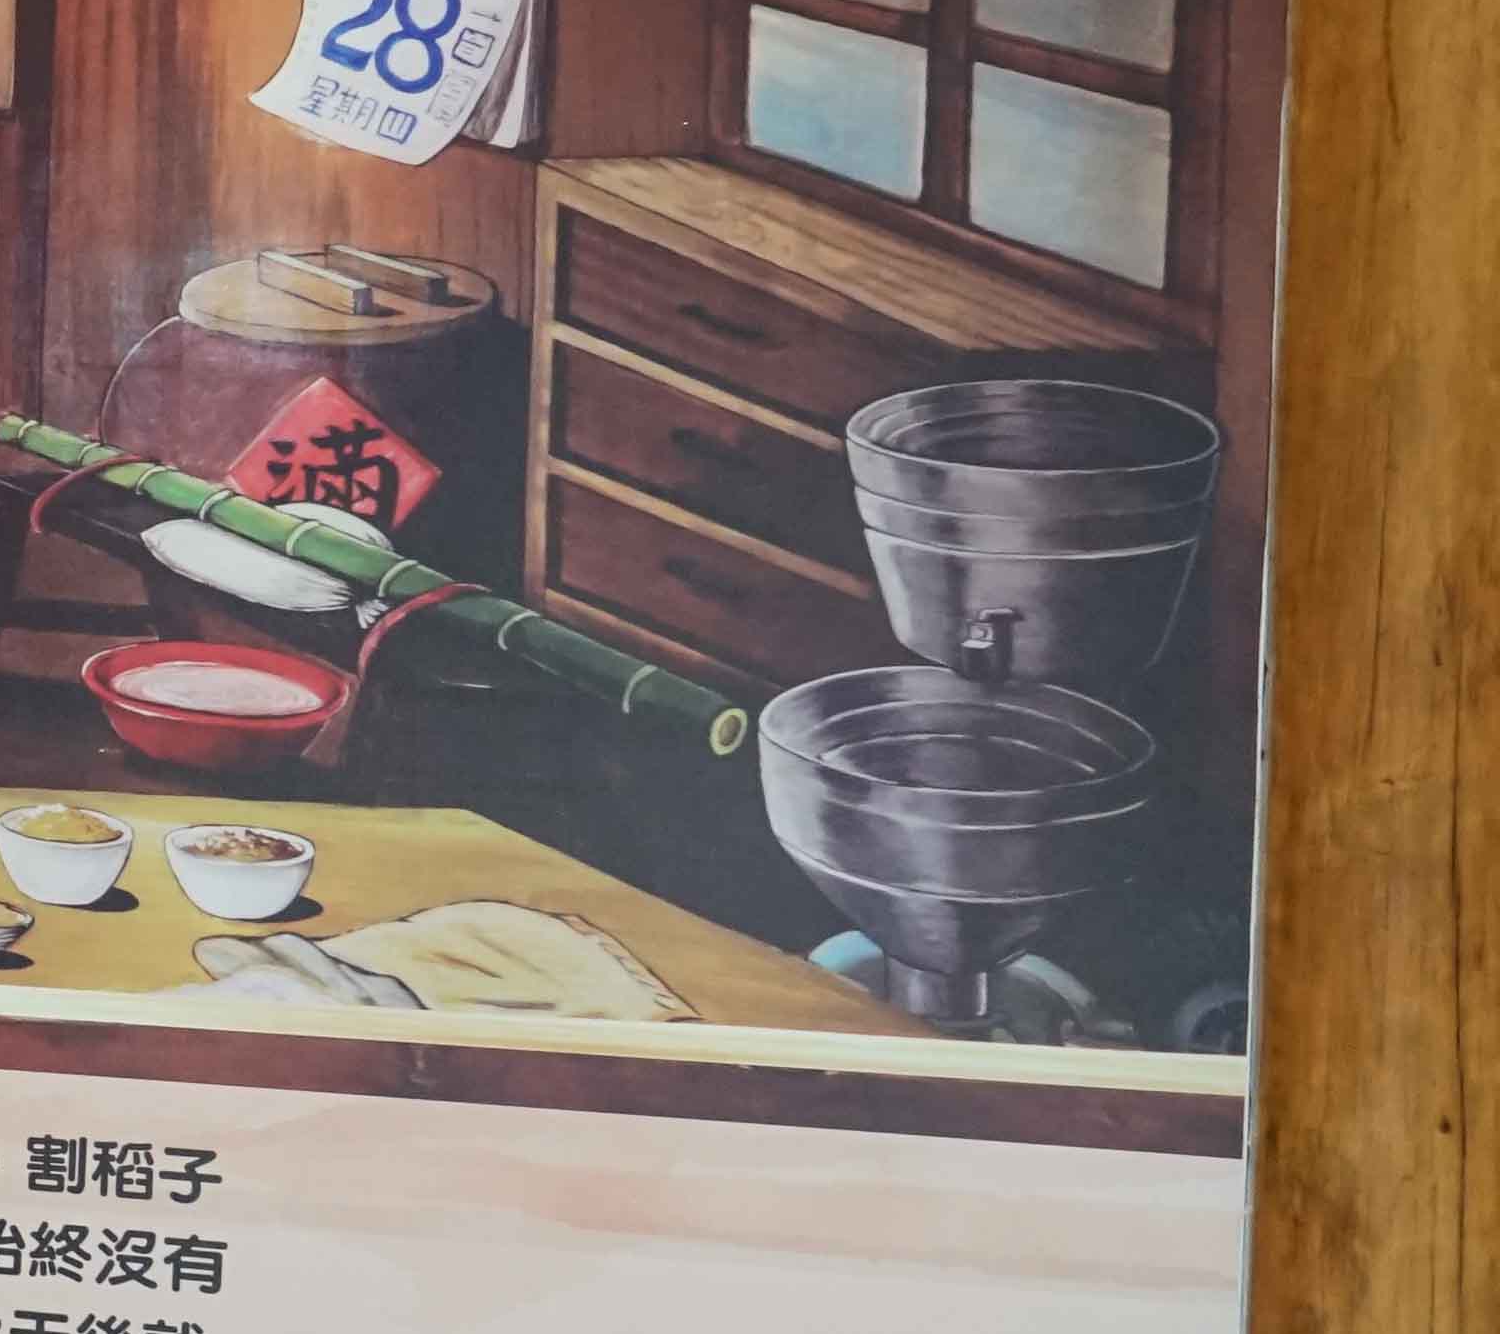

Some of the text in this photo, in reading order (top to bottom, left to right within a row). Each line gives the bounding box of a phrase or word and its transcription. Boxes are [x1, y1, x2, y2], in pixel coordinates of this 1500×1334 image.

[299, 74, 418, 146] 星期四
[266, 417, 401, 527] 滿
